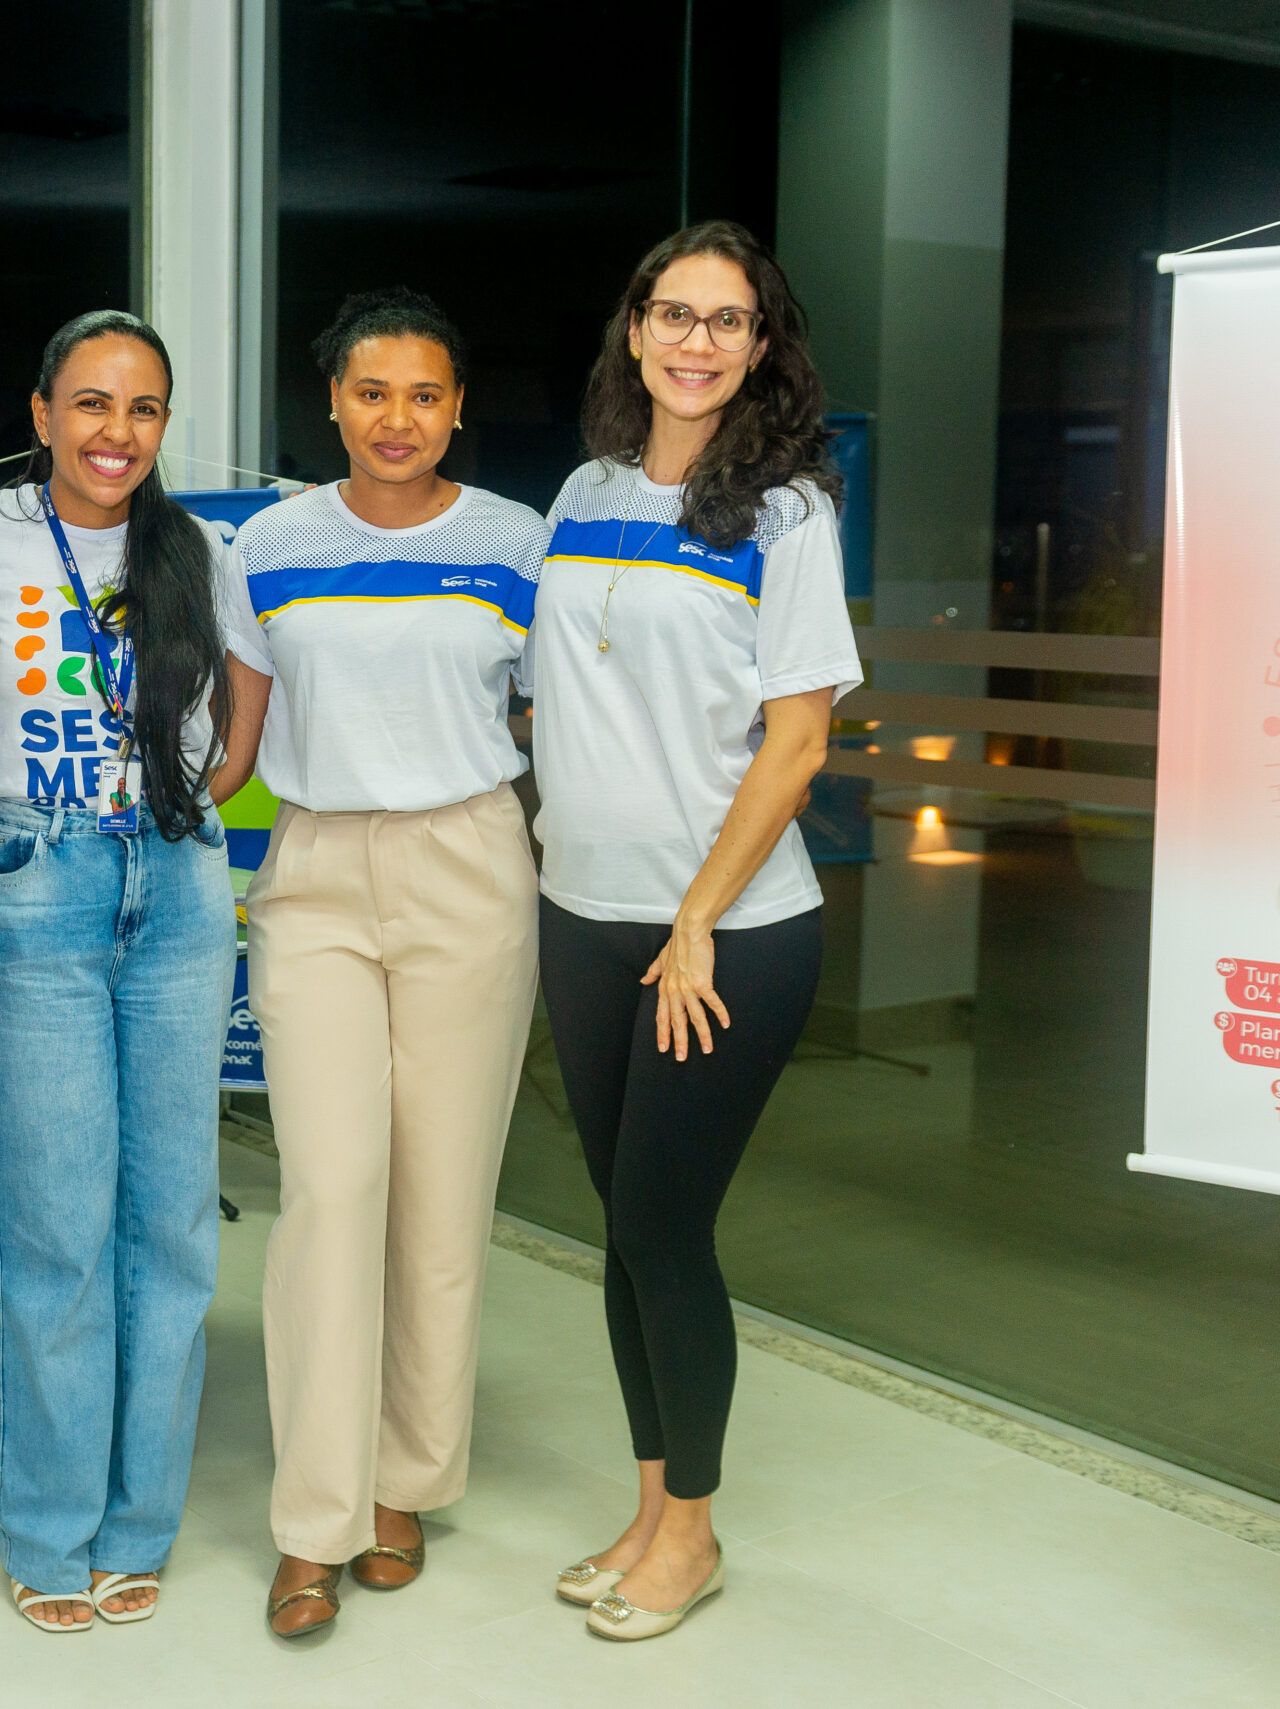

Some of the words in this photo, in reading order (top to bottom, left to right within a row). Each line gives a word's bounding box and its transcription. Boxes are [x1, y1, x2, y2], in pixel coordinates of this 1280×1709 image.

[440, 576, 472, 588] Sesc
[1243, 966, 1280, 985] Tur
[1243, 984, 1272, 1003] 04
